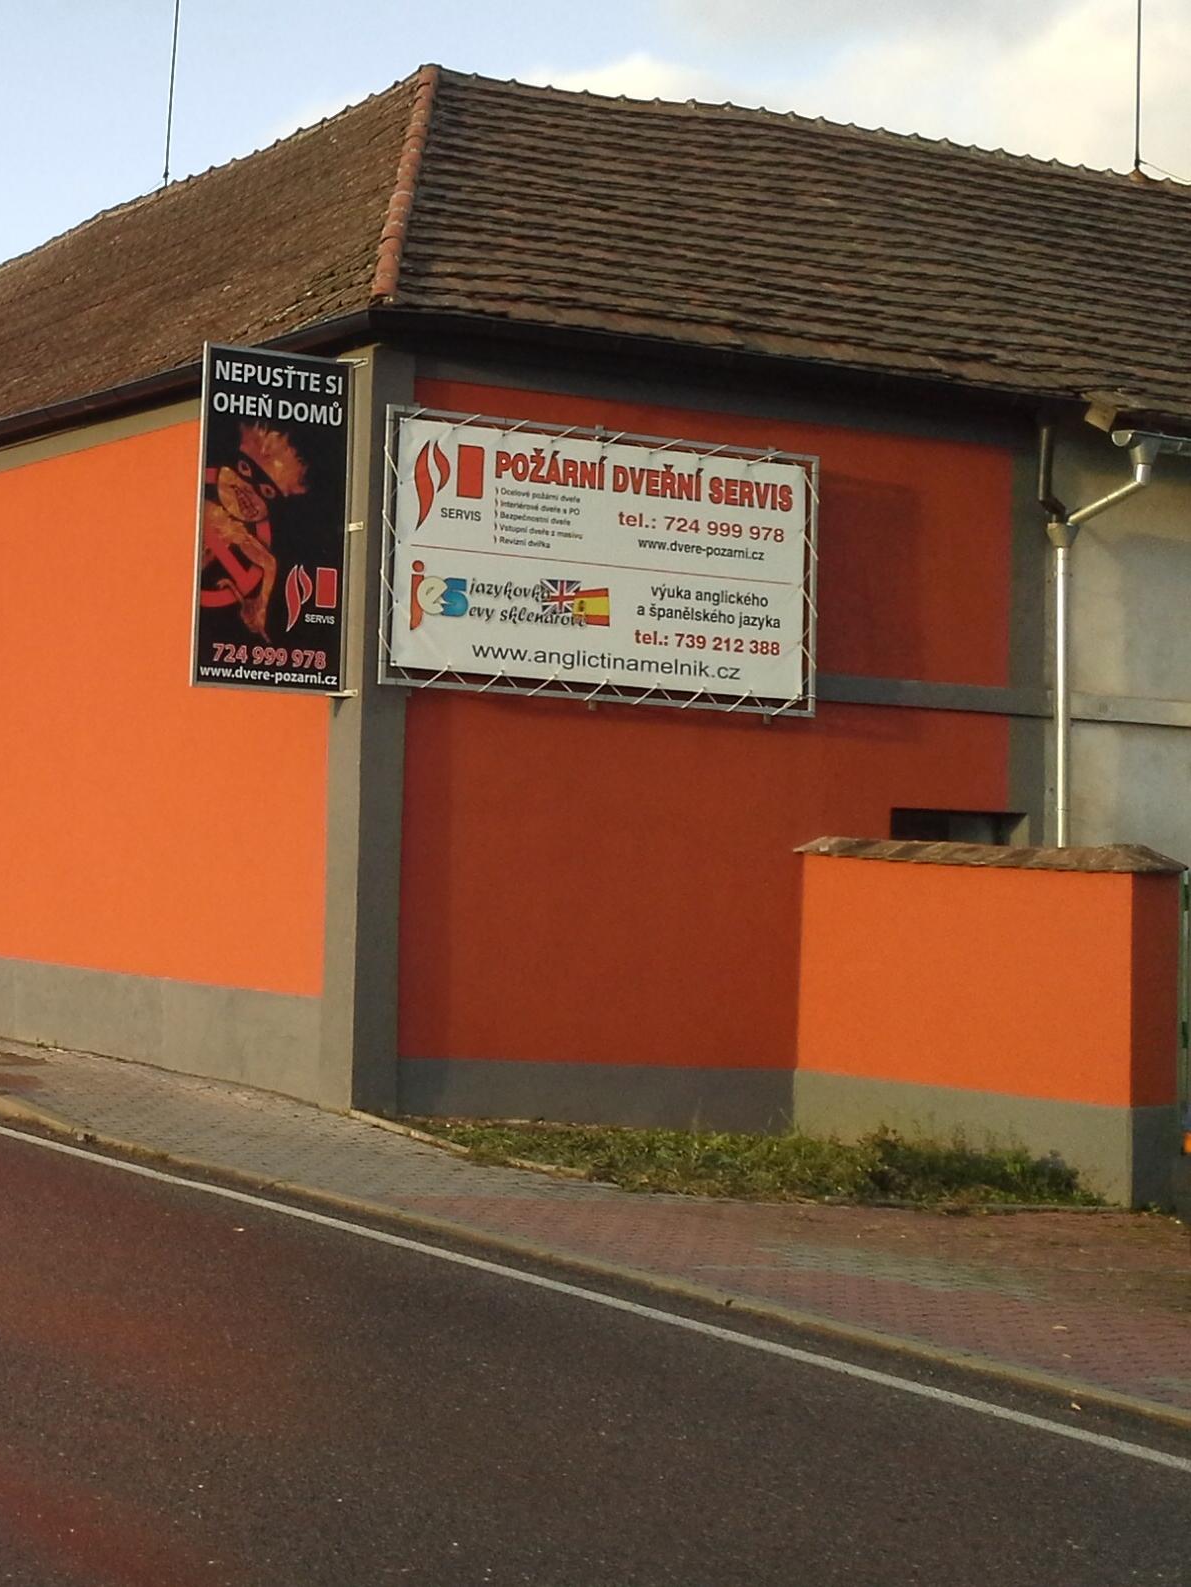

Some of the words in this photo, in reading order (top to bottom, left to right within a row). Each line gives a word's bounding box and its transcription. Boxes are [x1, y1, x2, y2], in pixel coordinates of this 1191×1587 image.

[215, 360, 321, 392] NEPUSŤTE
[325, 375, 343, 395] SI
[213, 392, 273, 418] OHEŇ
[278, 400, 343, 426] DOMŮ
[495, 448, 607, 490] POŽÁRNÍ
[612, 464, 704, 502] DVEŘNÍ
[709, 476, 793, 512] SERVIS
[501, 487, 530, 498] Ocelové
[532, 490, 559, 501] požární
[560, 495, 581, 504] dveře
[440, 508, 482, 522] SERVIS
[499, 511, 549, 524] Bezpečnostní
[551, 516, 571, 526] dveře
[541, 504, 561, 514] dveře
[569, 507, 581, 516] PO
[499, 523, 527, 534] Vstupní
[529, 527, 549, 536] dveře
[618, 512, 657, 529] tel.:
[664, 516, 700, 534] 724
[707, 521, 743, 538] 999
[749, 526, 785, 543] 978
[499, 536, 527, 546] Revizní
[637, 539, 765, 561] www.dvere-pozarni.cz
[651, 584, 691, 601] výuka
[695, 590, 769, 608] anglického
[304, 613, 335, 625] SERVIS
[469, 606, 495, 621] evy
[637, 604, 645, 616] a
[649, 603, 735, 624] španělského
[738, 612, 781, 630] jazyka
[634, 630, 669, 646] tel.:
[675, 633, 707, 649] 739
[712, 637, 744, 653] 212
[749, 640, 781, 656] 388
[212, 643, 248, 664] 724
[251, 646, 288, 666] 999
[291, 649, 327, 670] 978
[471, 644, 741, 680] www.anglictinamelnik.cz
[199, 666, 338, 686] www.dvere-pozarni.cz
